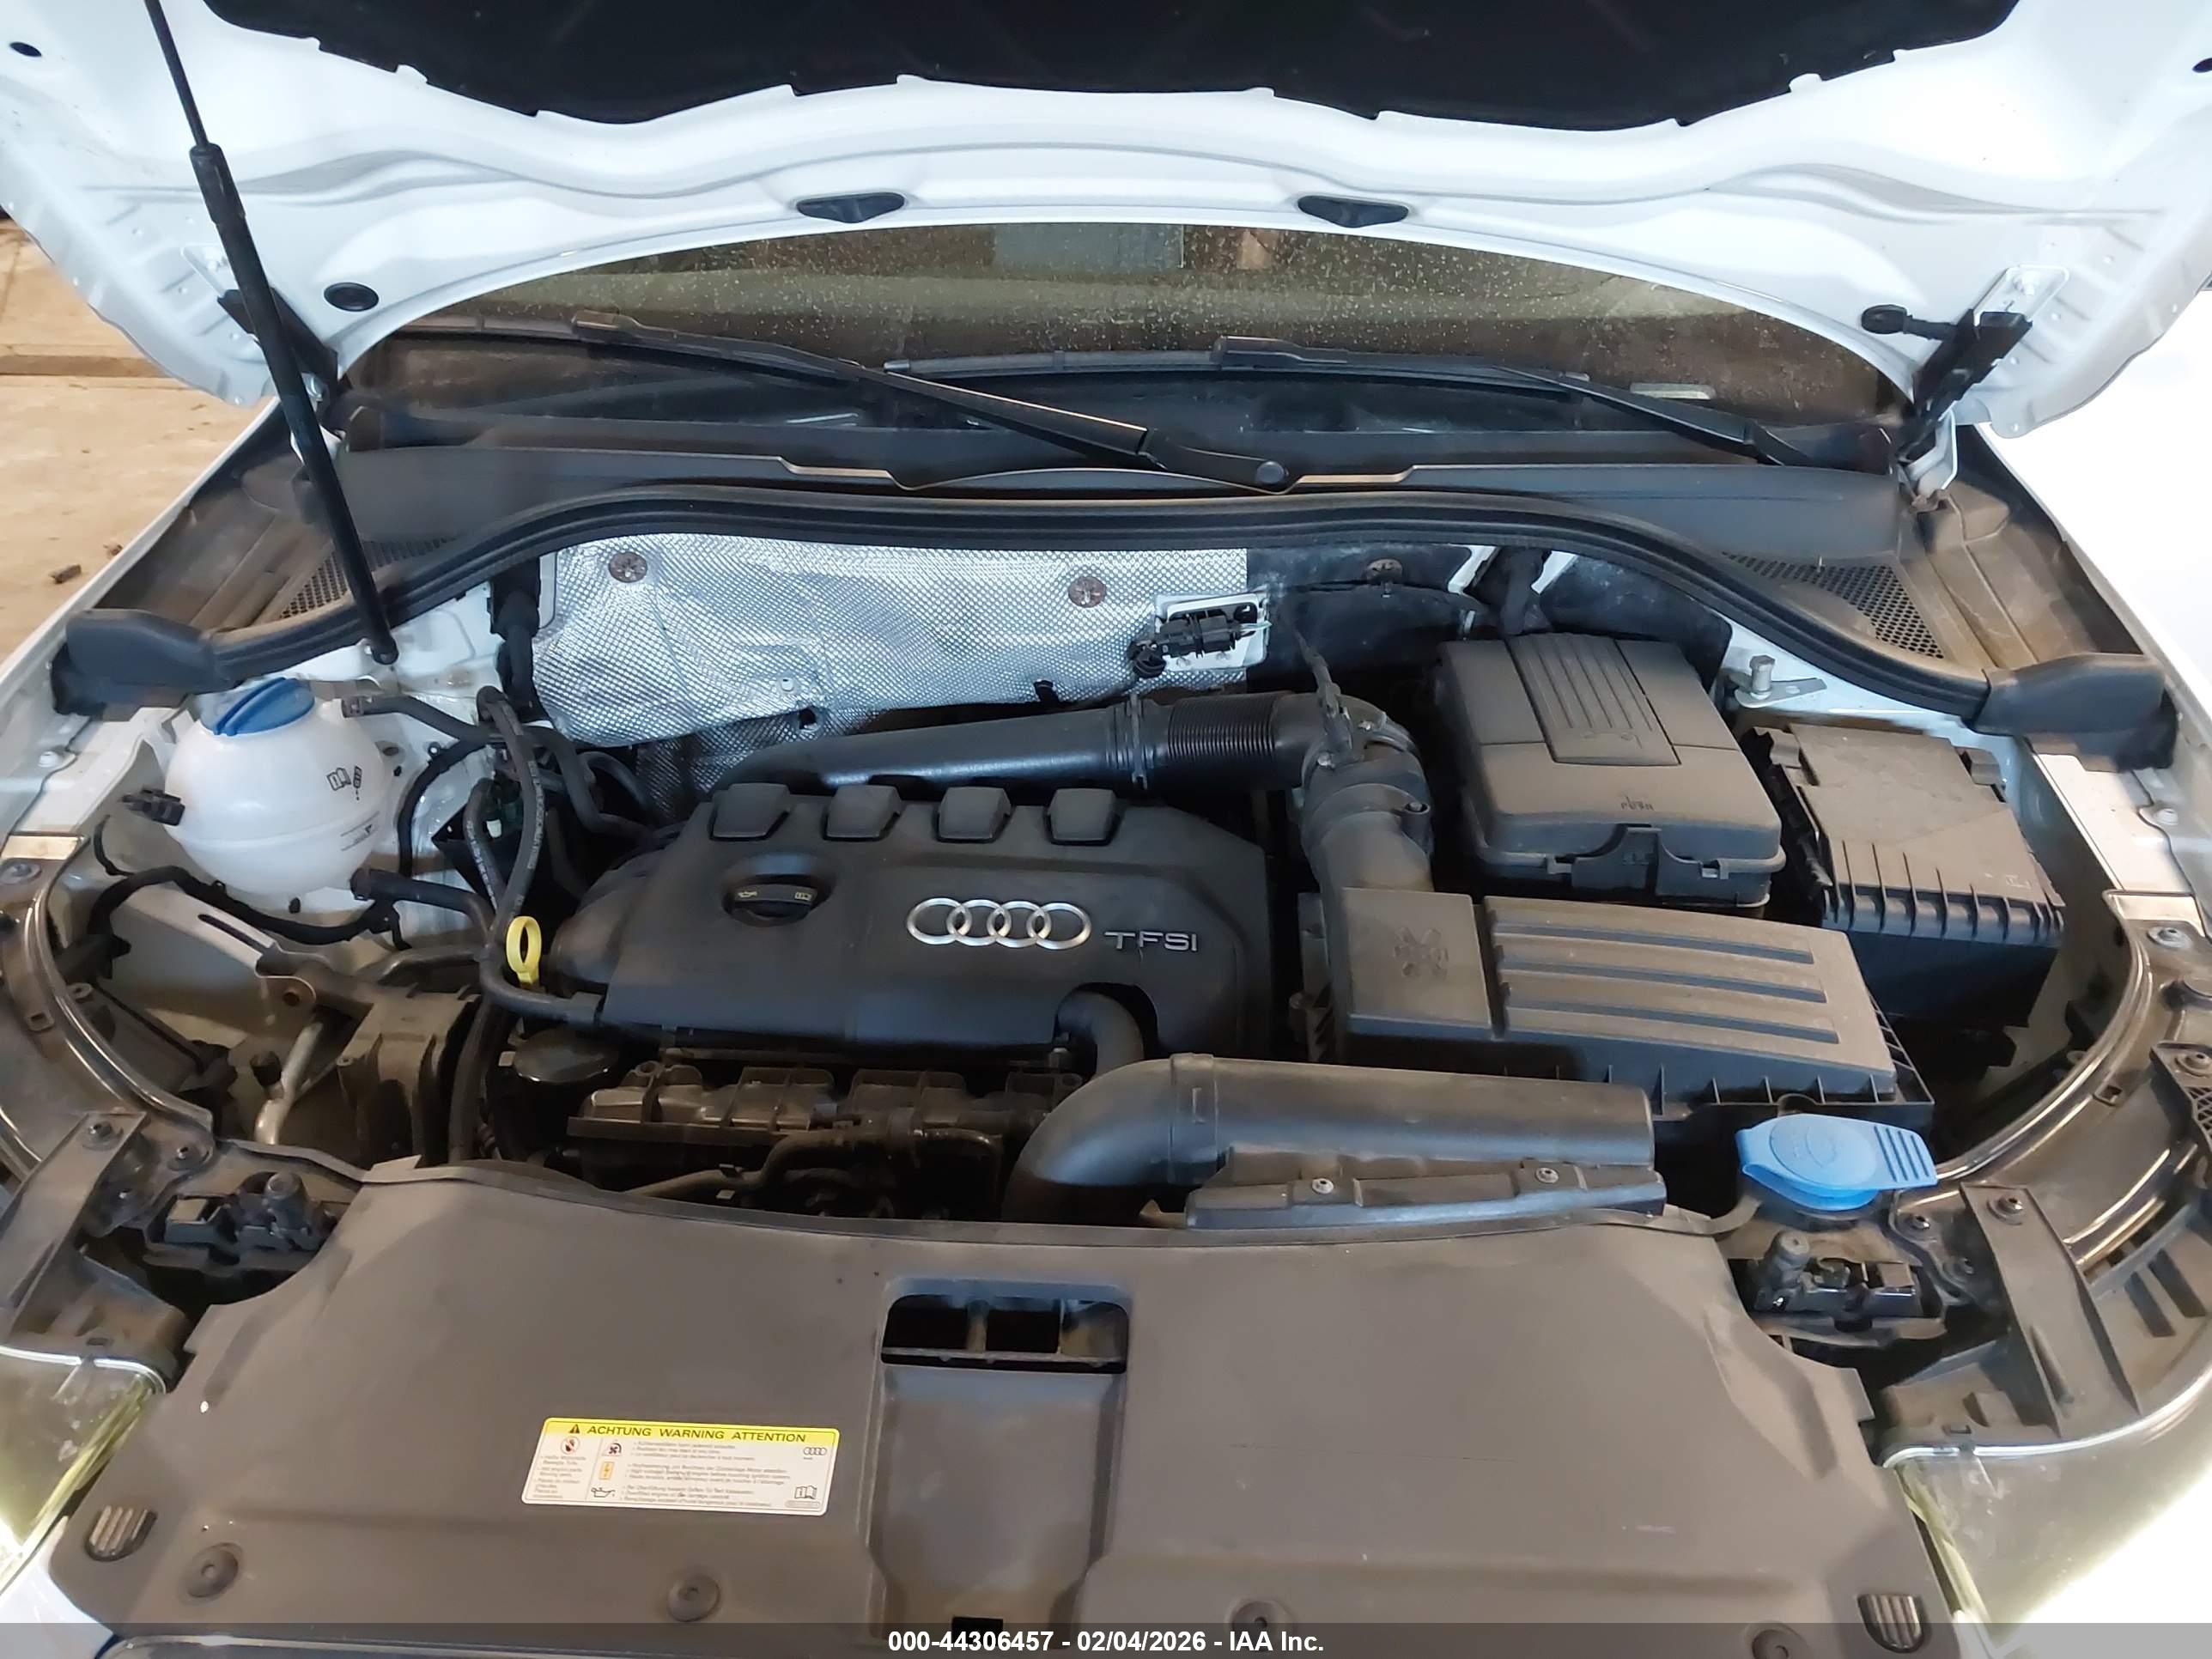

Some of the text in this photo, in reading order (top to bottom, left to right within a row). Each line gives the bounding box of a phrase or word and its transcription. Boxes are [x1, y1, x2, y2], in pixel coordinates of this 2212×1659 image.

[1103, 931, 1198, 951] TFSI
[586, 1425, 807, 1443] ACHTUNG WARNING ATTENTION
